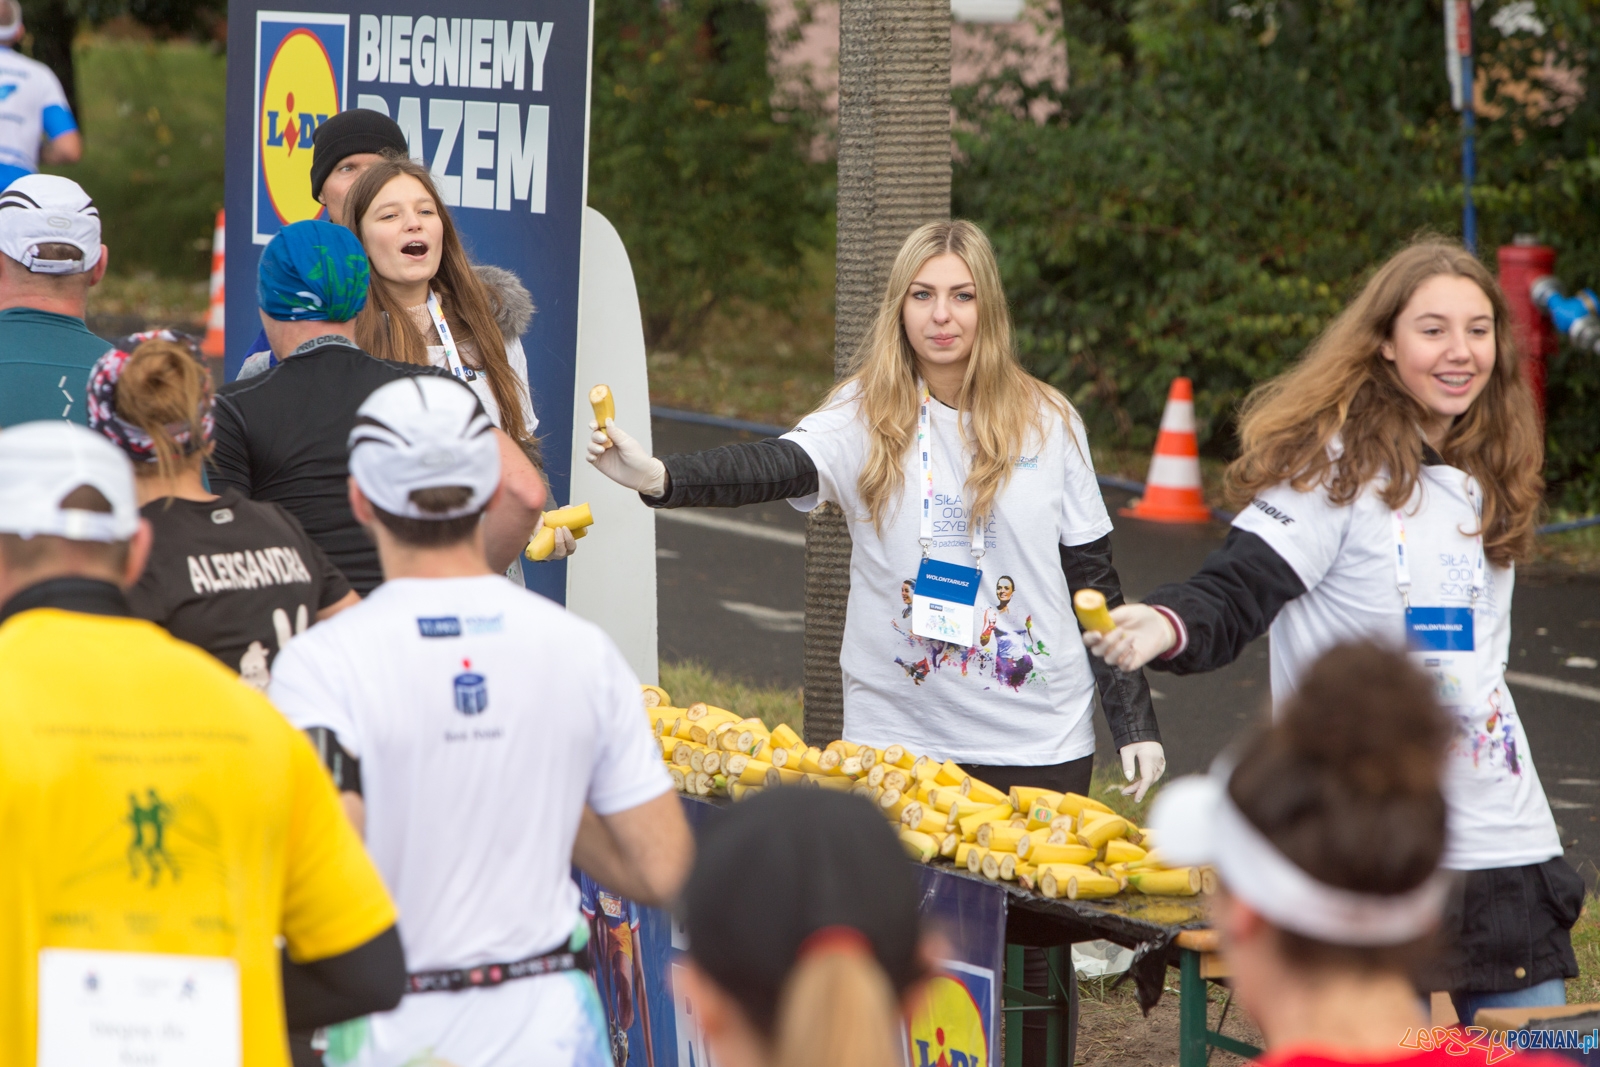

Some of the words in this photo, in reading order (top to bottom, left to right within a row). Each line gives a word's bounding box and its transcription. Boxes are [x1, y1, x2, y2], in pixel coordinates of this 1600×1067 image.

[357, 14, 554, 91] BIEGNIEMY
[357, 94, 550, 214] AZEM
[934, 494, 963, 506] SIŁA
[942, 507, 997, 520] ODWA
[932, 520, 997, 534] SZYBĆ
[932, 540, 938, 549] 9
[1439, 553, 1470, 567] SIŁA
[186, 546, 312, 594] ALEKSANDRA
[926, 573, 970, 588] WOLONTARIUSZ
[1413, 623, 1463, 632] WOLONTARIUSZ
